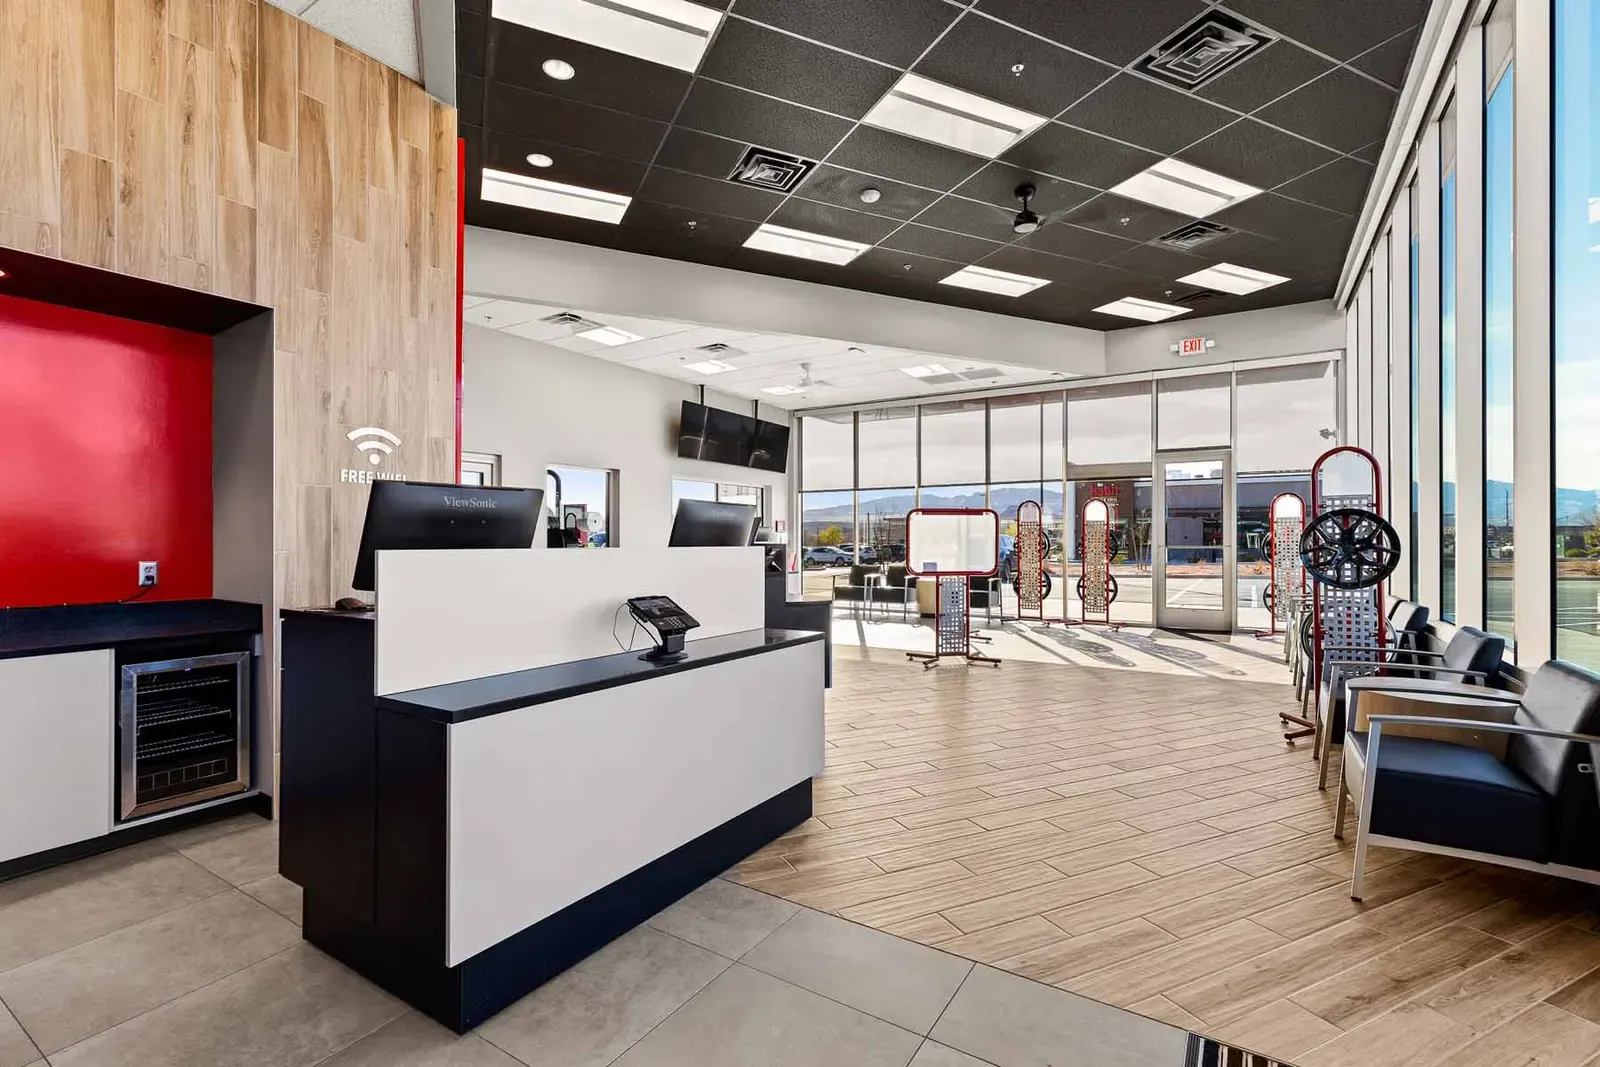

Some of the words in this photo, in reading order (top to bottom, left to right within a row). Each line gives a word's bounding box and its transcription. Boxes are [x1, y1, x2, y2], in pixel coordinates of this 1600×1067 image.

[1183, 339, 1202, 352] EXIT
[340, 469, 373, 484] FREE
[443, 496, 498, 509] ViewSonic
